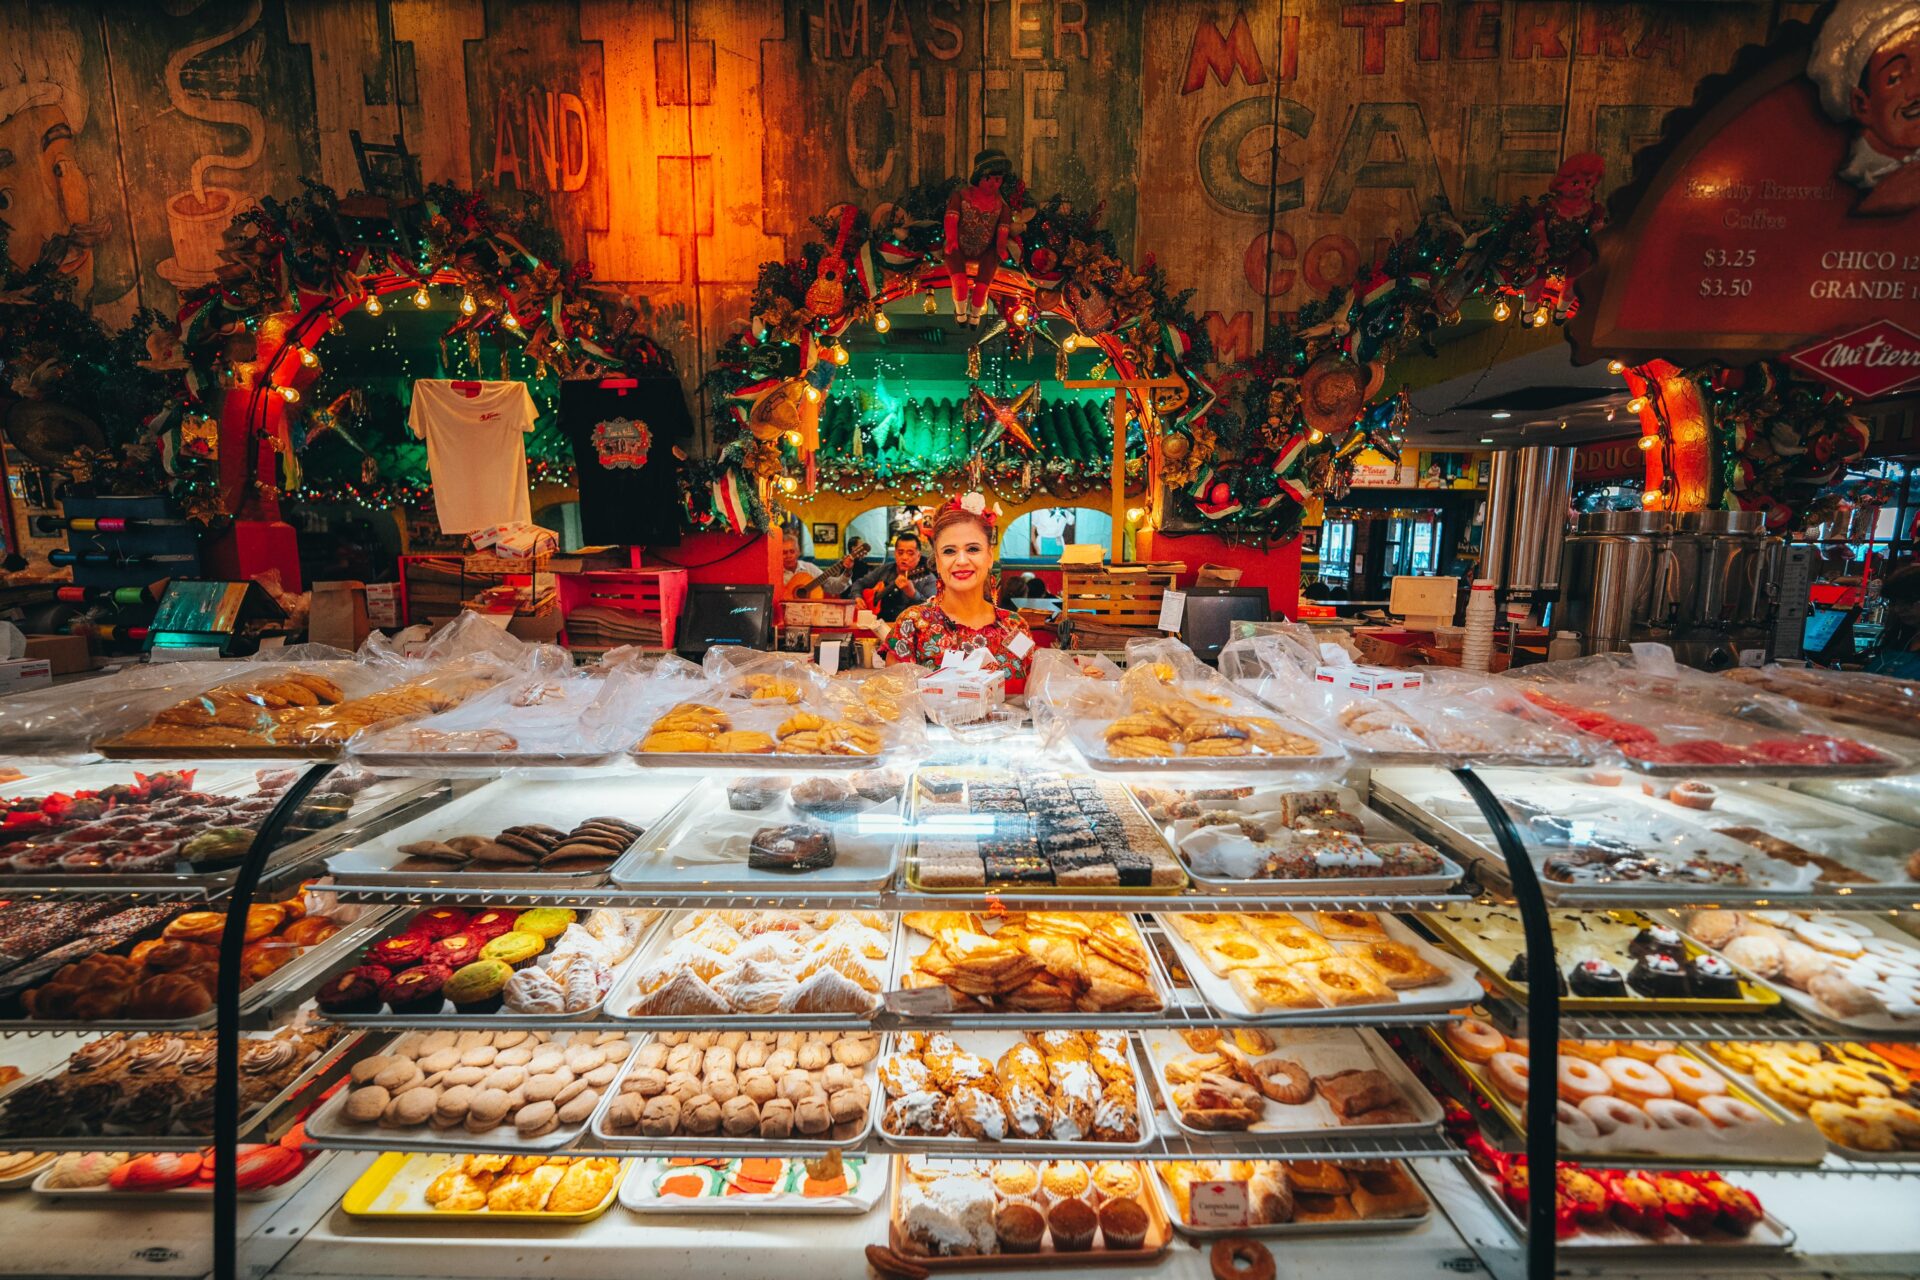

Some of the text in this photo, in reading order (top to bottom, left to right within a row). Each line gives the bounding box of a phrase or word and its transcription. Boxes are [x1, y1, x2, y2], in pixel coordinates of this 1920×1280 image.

[1181, 3, 1688, 95] MI TIERRA
[847, 58, 1067, 191] CHEF
[493, 87, 591, 192] AND
[1759, 178, 1835, 201] Brewed
[1722, 208, 1787, 230] Coffee
[1703, 248, 1920, 271] $3.25 CHICO 12
[1699, 278, 1752, 297] $3.50
[1810, 280, 1906, 300] GRANDE
[1362, 465, 1388, 475] Please
